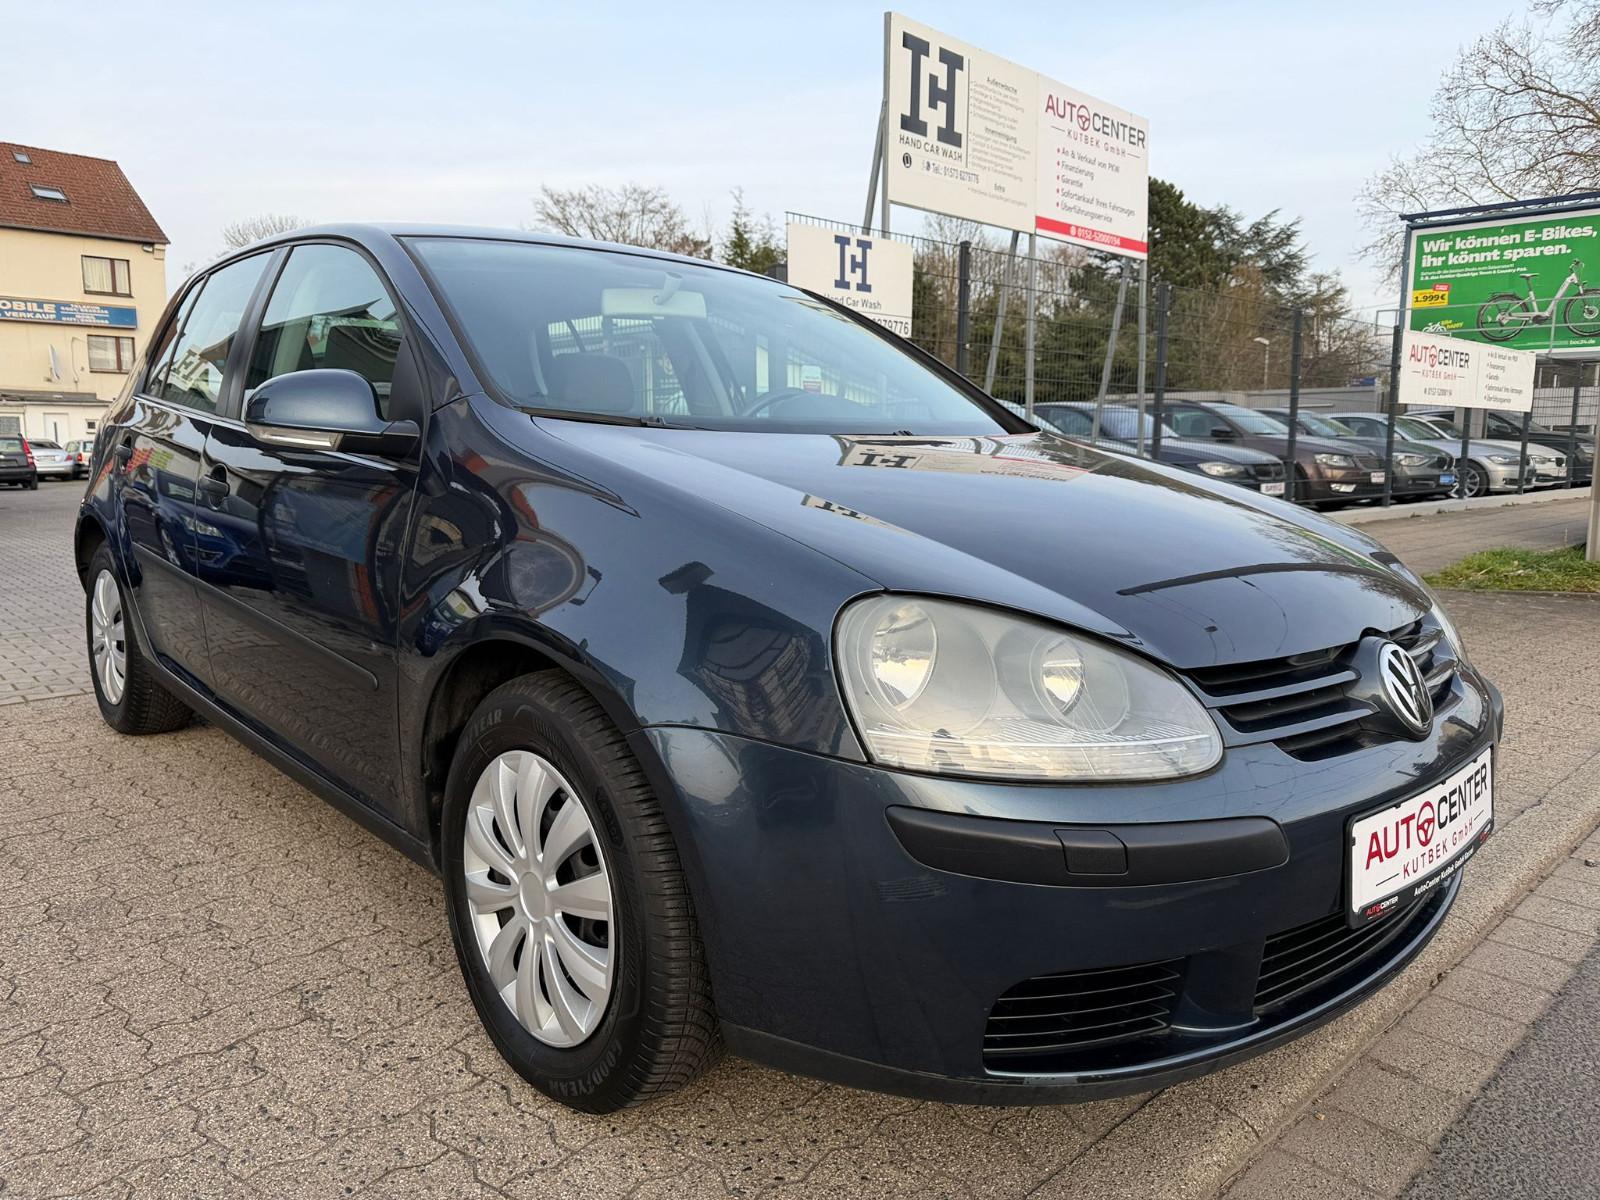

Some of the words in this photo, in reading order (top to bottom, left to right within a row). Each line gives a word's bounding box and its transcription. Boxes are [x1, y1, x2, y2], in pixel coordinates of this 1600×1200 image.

[899, 134, 921, 150] HAND
[924, 142, 940, 156] CAR
[941, 148, 962, 163] WASH
[1067, 129, 1100, 148] KUTBEK
[1104, 142, 1126, 157] GmbH
[1062, 147, 1070, 156] An
[1077, 152, 1097, 166] Verkauf
[1061, 160, 1095, 181] Finanzierung
[1061, 174, 1083, 188] Garantie
[1423, 239, 1453, 253] Wir
[1456, 233, 1520, 250] können
[1524, 225, 1597, 243] E-Bikes,
[1421, 254, 1447, 268] ihr
[1448, 248, 1500, 265] könnt
[1503, 243, 1572, 261] sparen.
[846, 297, 860, 306] Car
[861, 298, 882, 310] Wash
[4, 311, 56, 320] VERKAUF
[1403, 838, 1448, 879] KUTBEK
[1452, 817, 1473, 846] GmbH
[1414, 875, 1440, 896] AutoCenter
